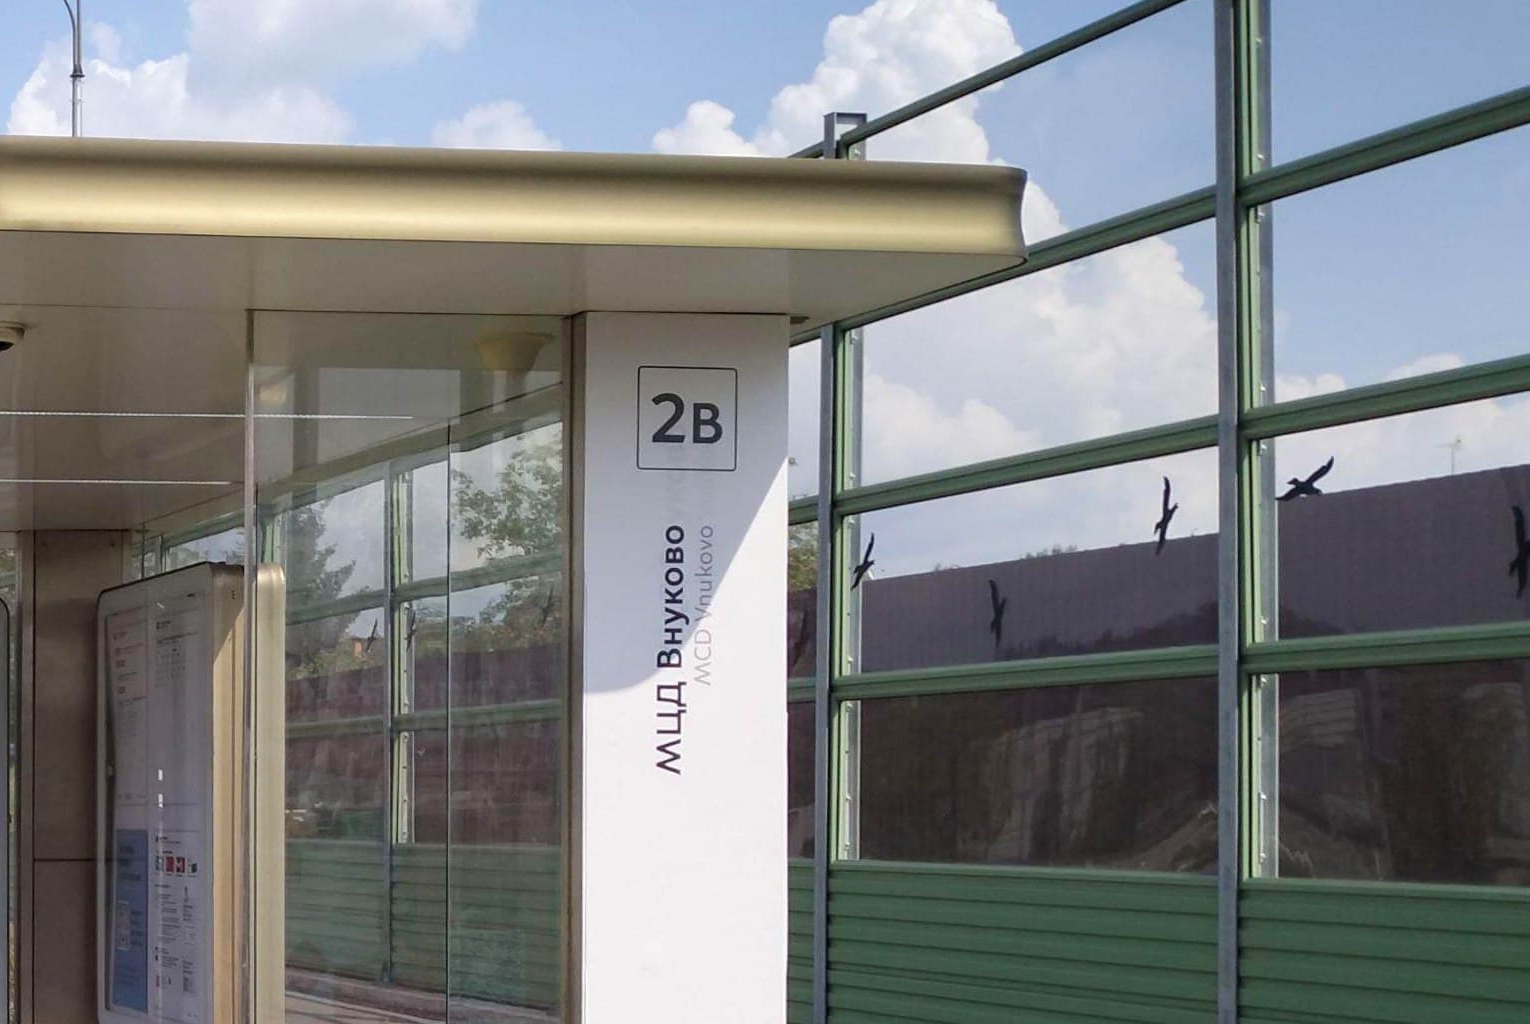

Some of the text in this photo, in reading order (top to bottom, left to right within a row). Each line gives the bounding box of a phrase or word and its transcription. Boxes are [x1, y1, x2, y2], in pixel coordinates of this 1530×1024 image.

[656, 525, 690, 668] Внуково
[693, 525, 714, 686] MCD Vnukovo
[656, 681, 687, 775] МЦД
